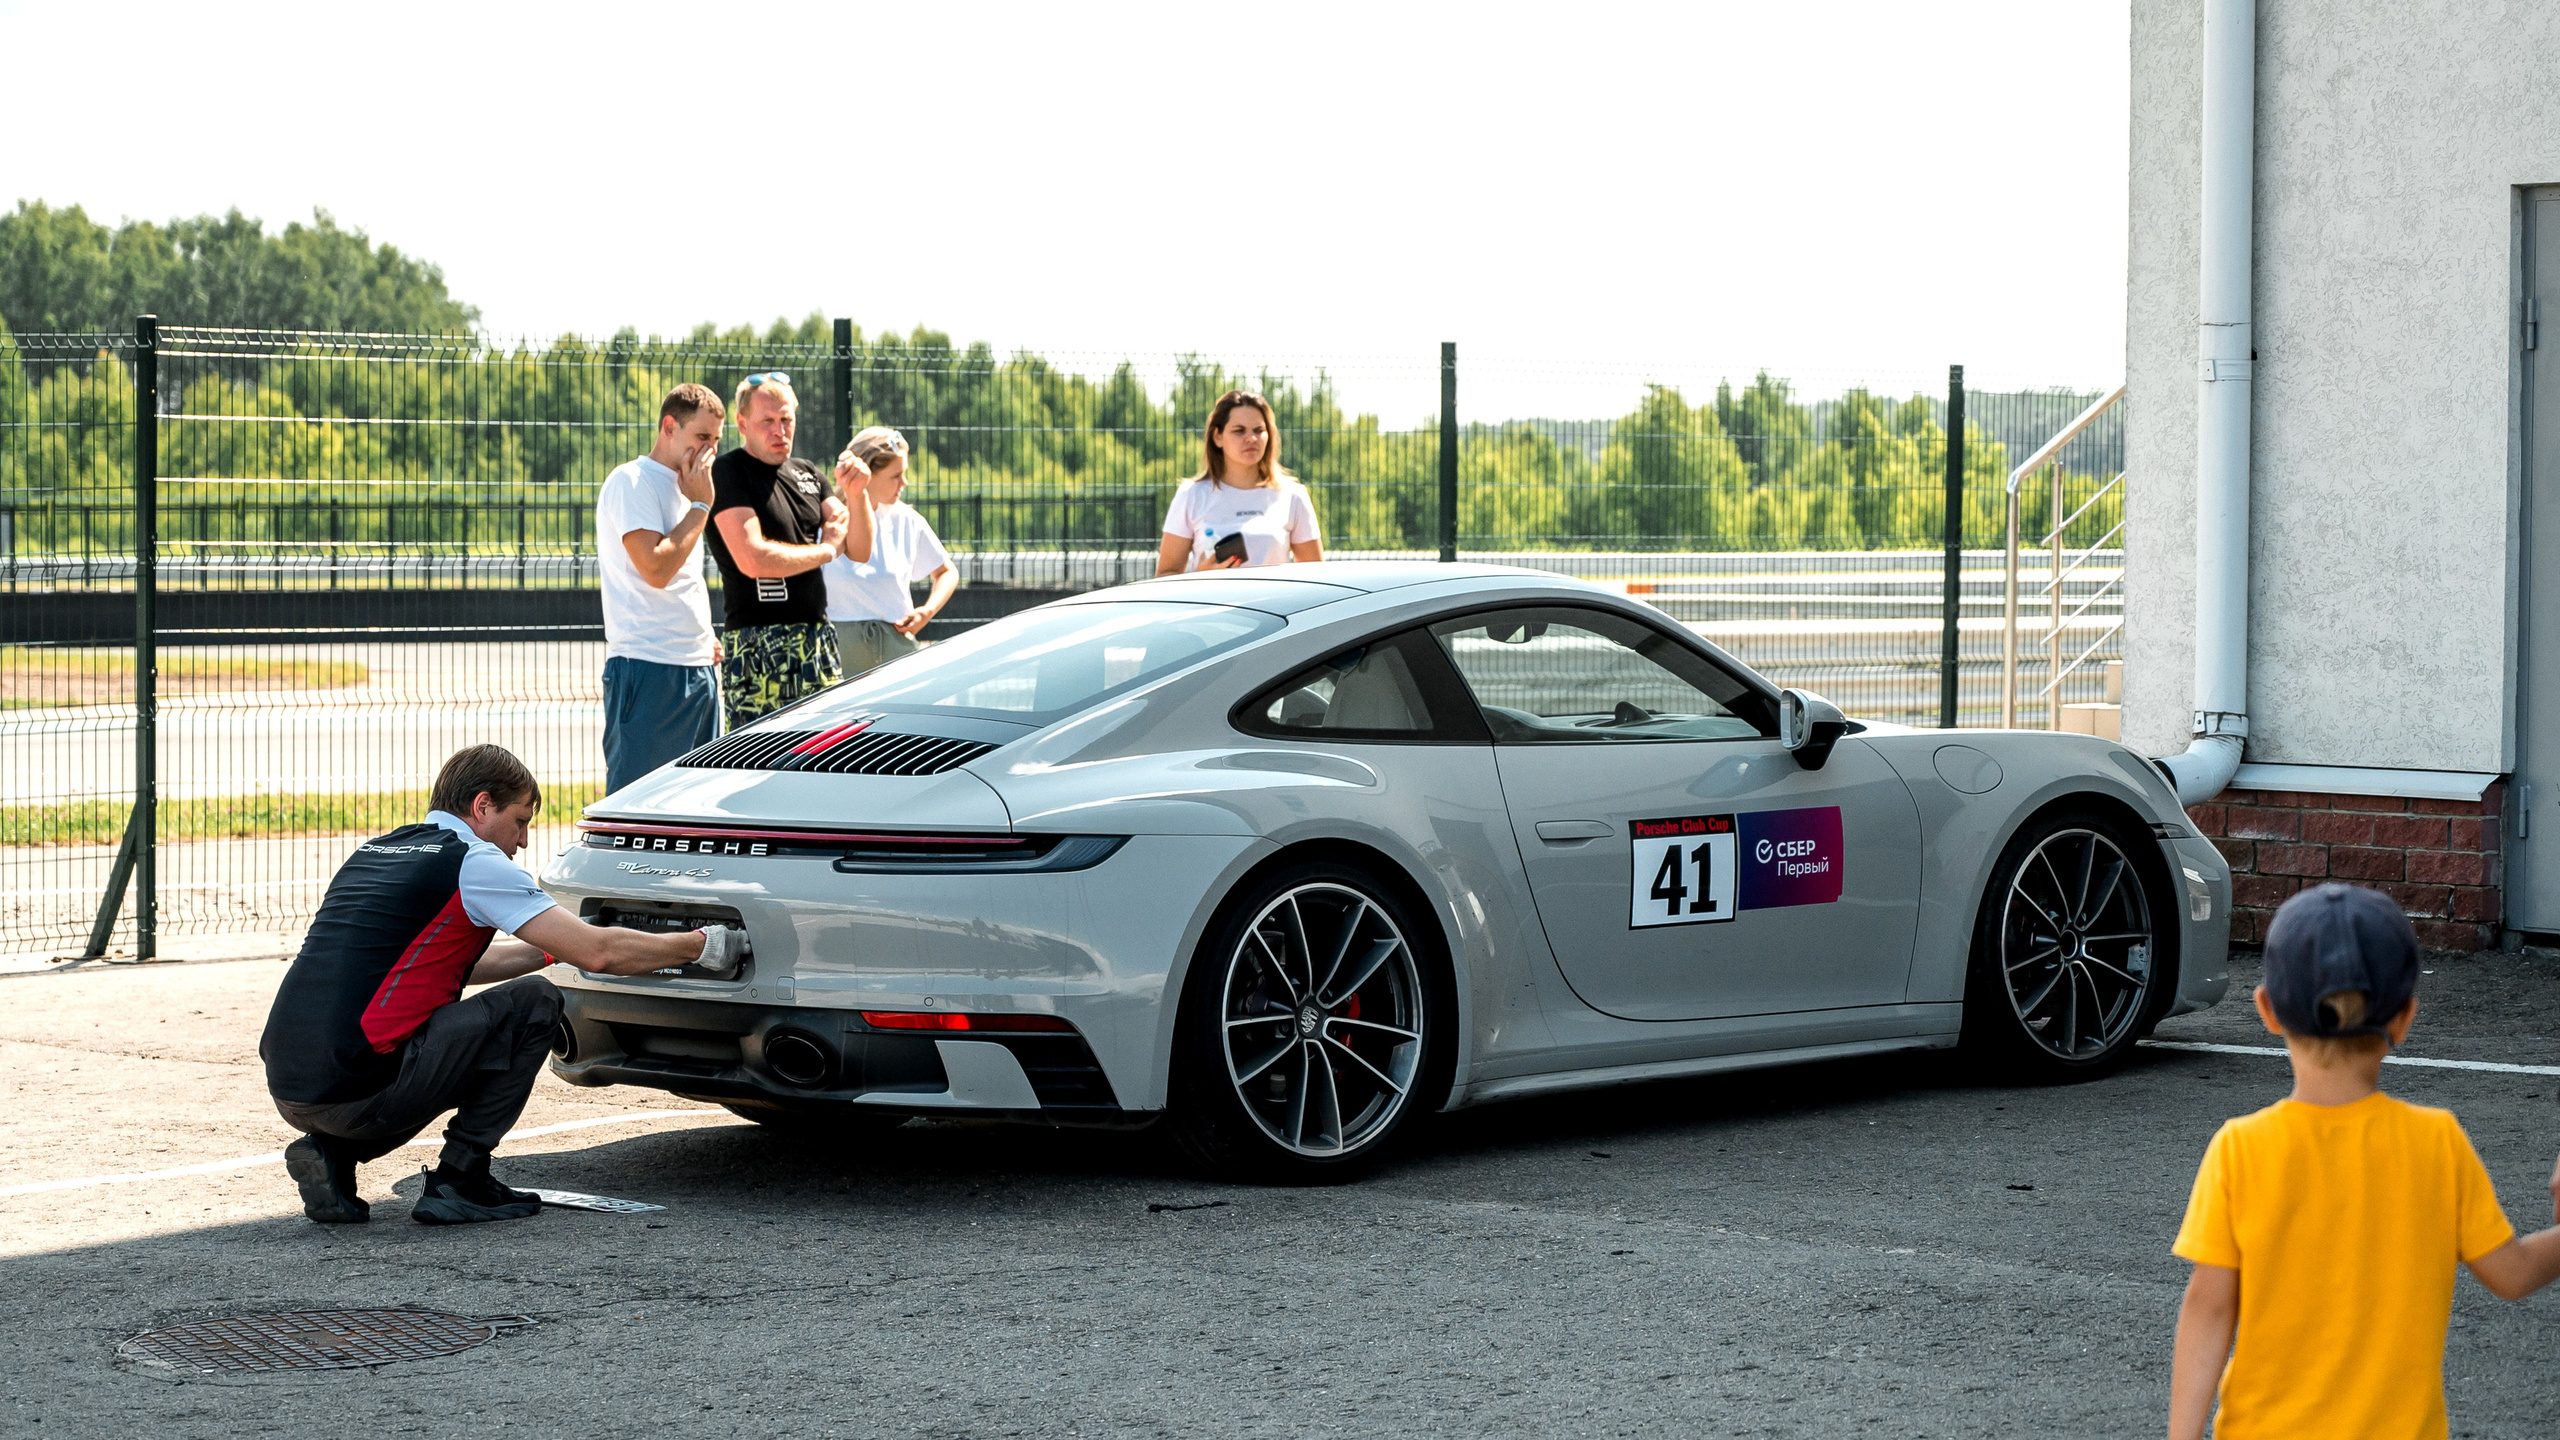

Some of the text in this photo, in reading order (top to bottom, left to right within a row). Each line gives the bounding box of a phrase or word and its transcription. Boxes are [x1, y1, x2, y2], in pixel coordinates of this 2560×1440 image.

[1636, 817, 1729, 836] Porsche Club Cup
[357, 844, 443, 854] ORSCHE
[613, 836, 768, 856] PORSCHE
[1776, 840, 1816, 858] СБЕР
[629, 864, 681, 876] Carrera
[684, 868, 714, 877] 4S
[1777, 857, 1829, 878] Первый
[1650, 842, 1717, 916] 41
